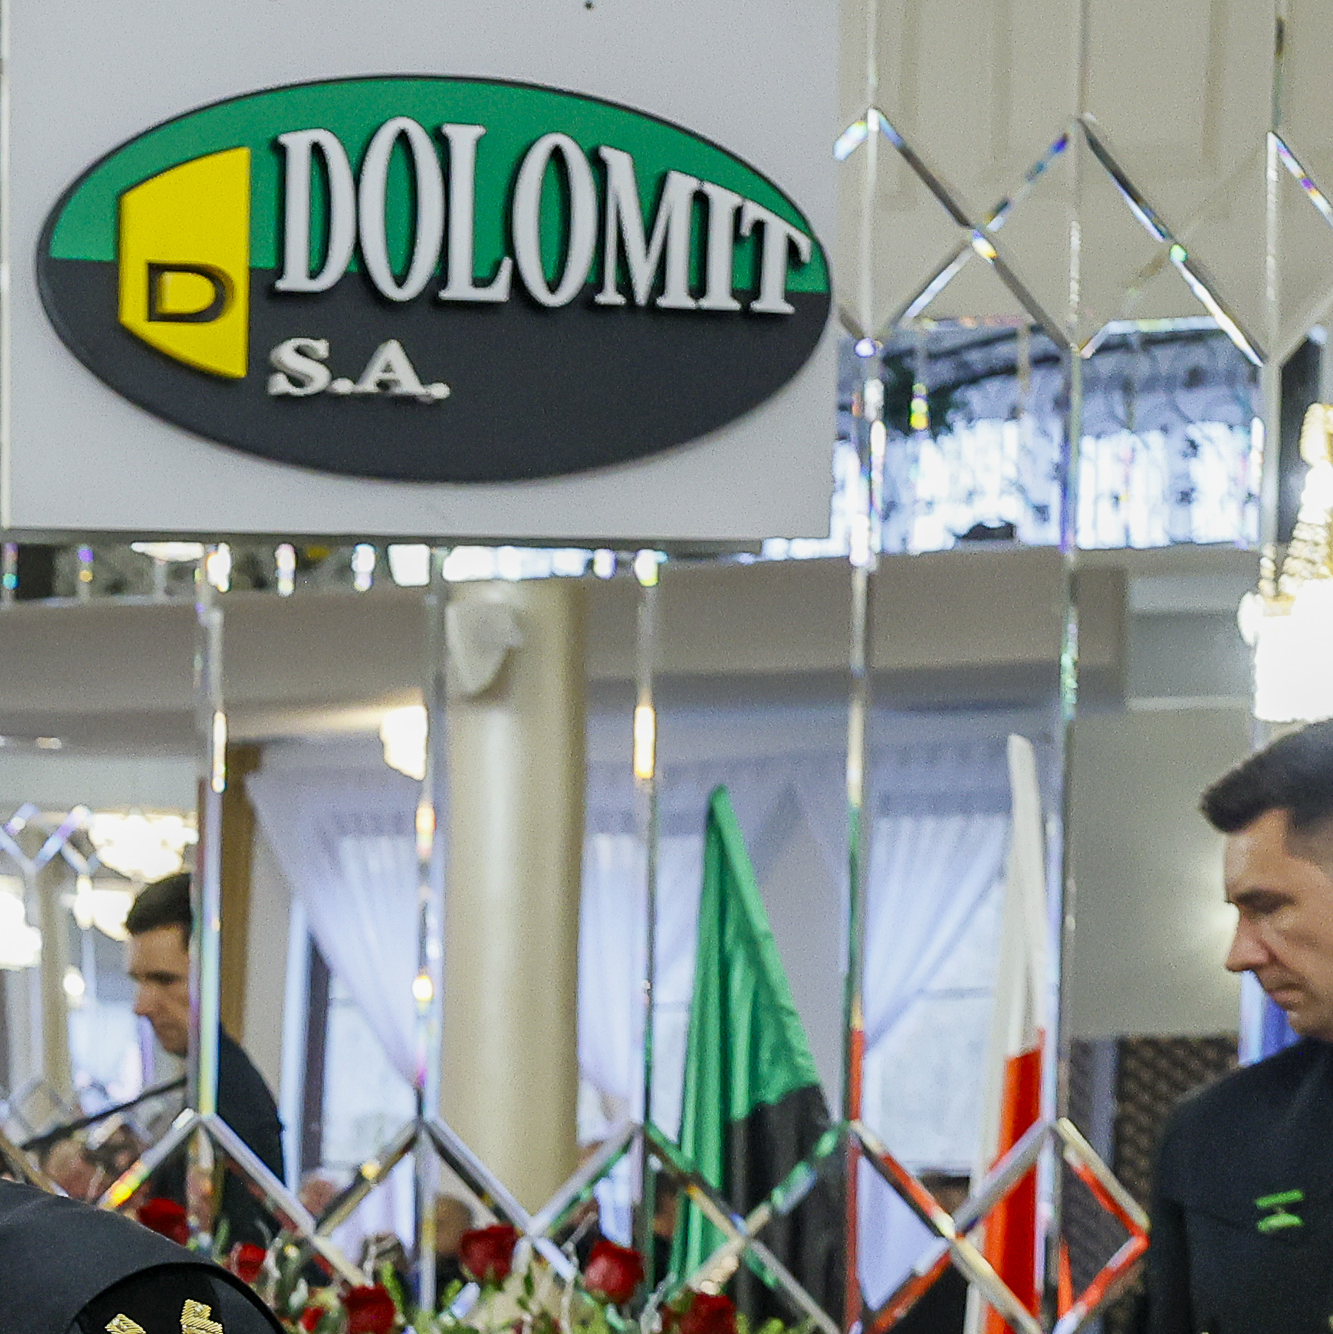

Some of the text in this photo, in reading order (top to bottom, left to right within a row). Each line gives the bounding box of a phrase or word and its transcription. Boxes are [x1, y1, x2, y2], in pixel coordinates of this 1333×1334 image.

[275, 117, 811, 315] DOLOMIT
[146, 262, 233, 323] D
[268, 336, 452, 401] S.A.
